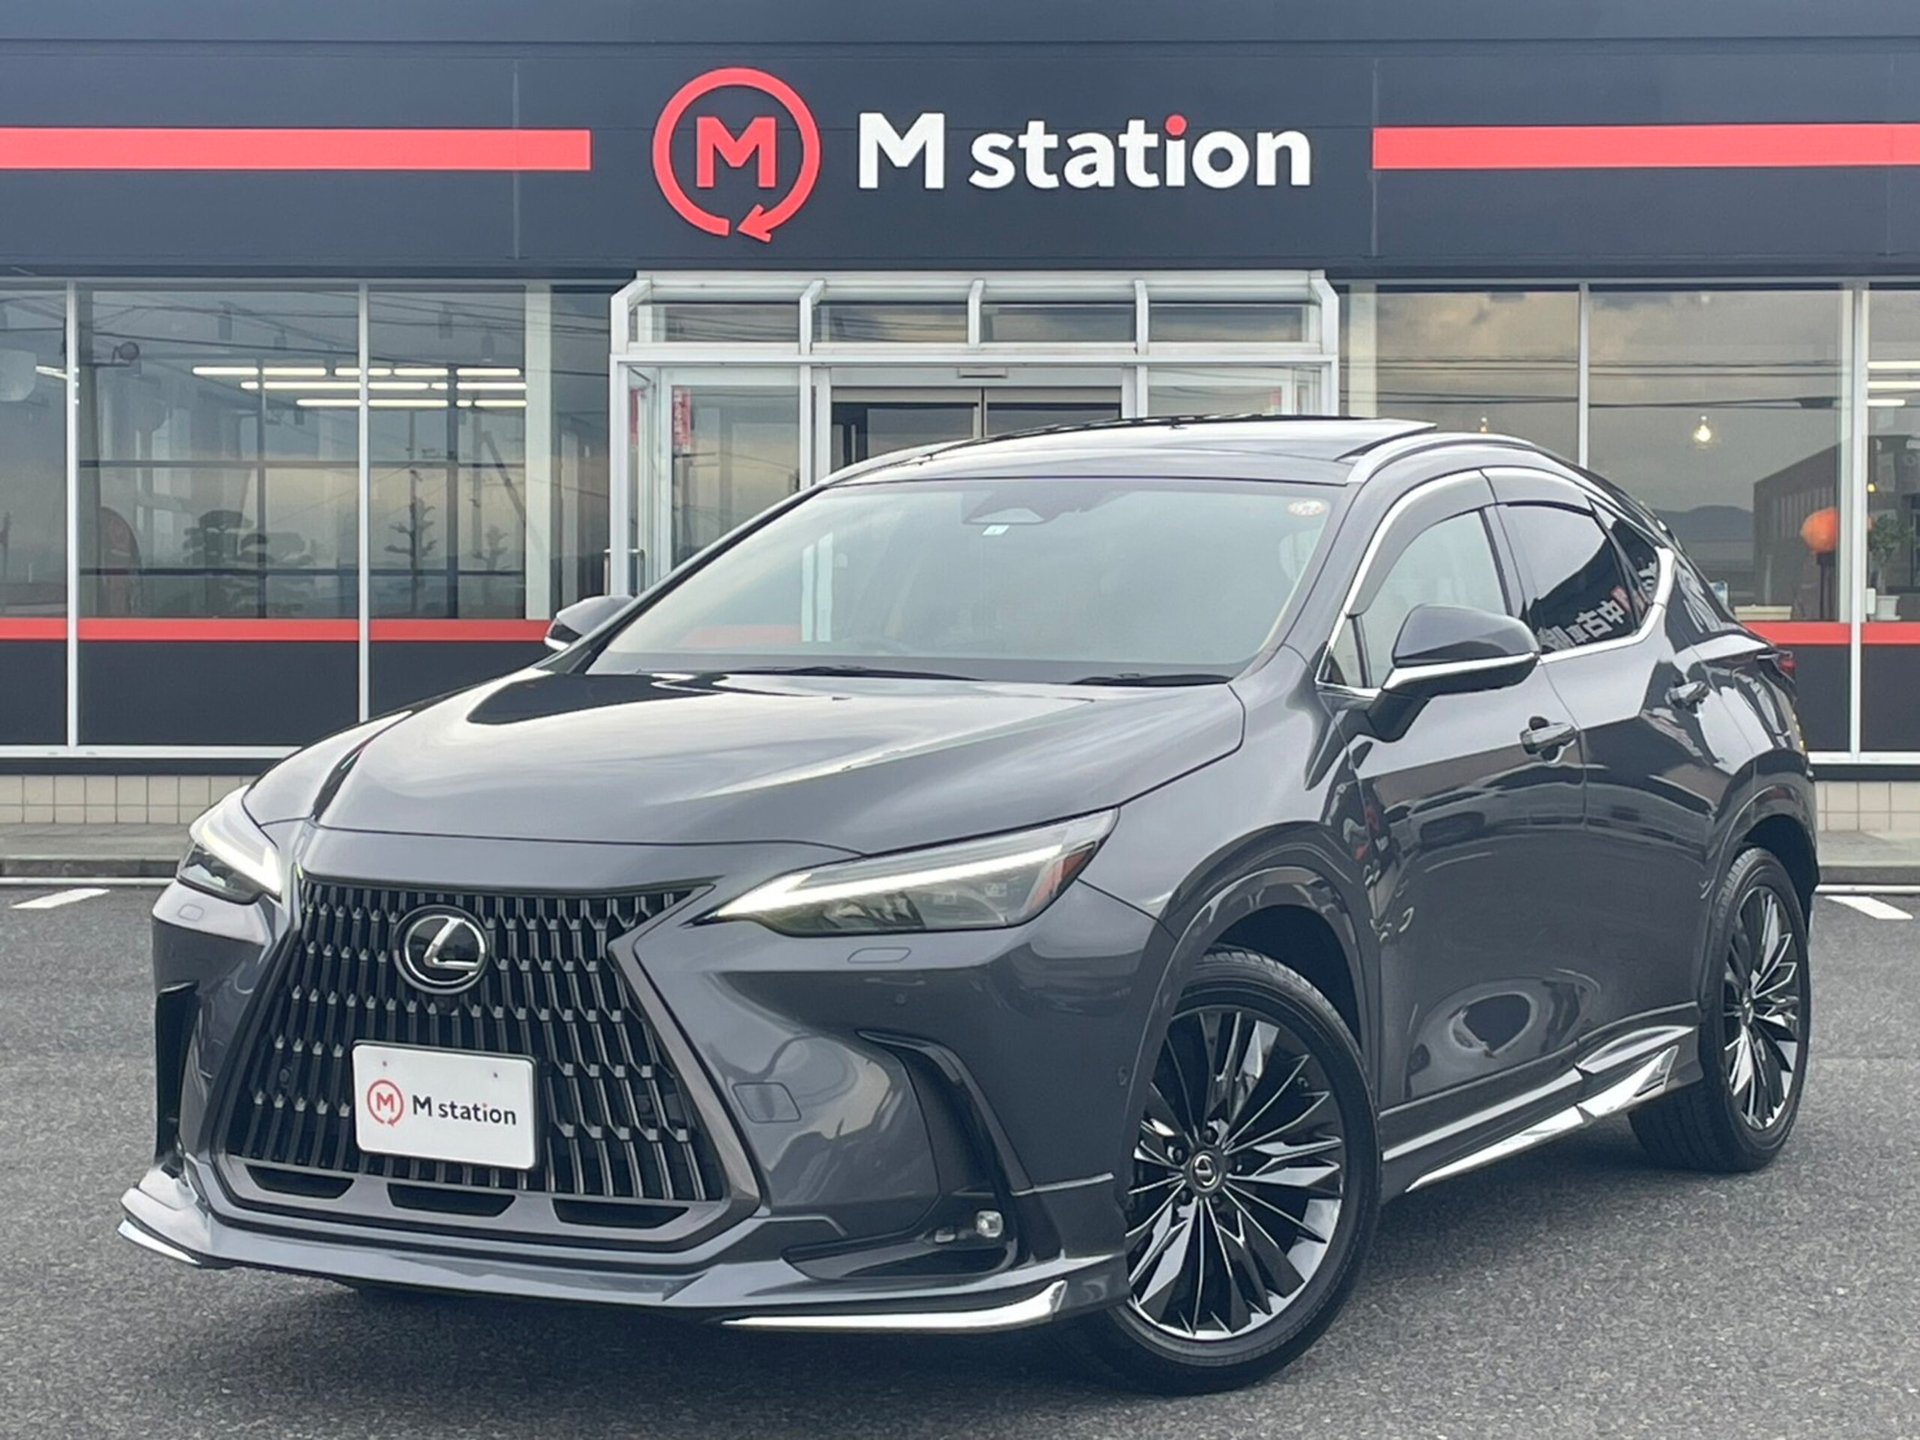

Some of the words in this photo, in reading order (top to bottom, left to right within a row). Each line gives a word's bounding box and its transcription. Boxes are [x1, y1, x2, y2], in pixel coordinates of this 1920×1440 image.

[696, 116, 777, 188] M
[859, 113, 944, 189] M
[969, 114, 1311, 189] station
[375, 1092, 395, 1112] M
[412, 1094, 433, 1117] M
[438, 1101, 517, 1126] station
